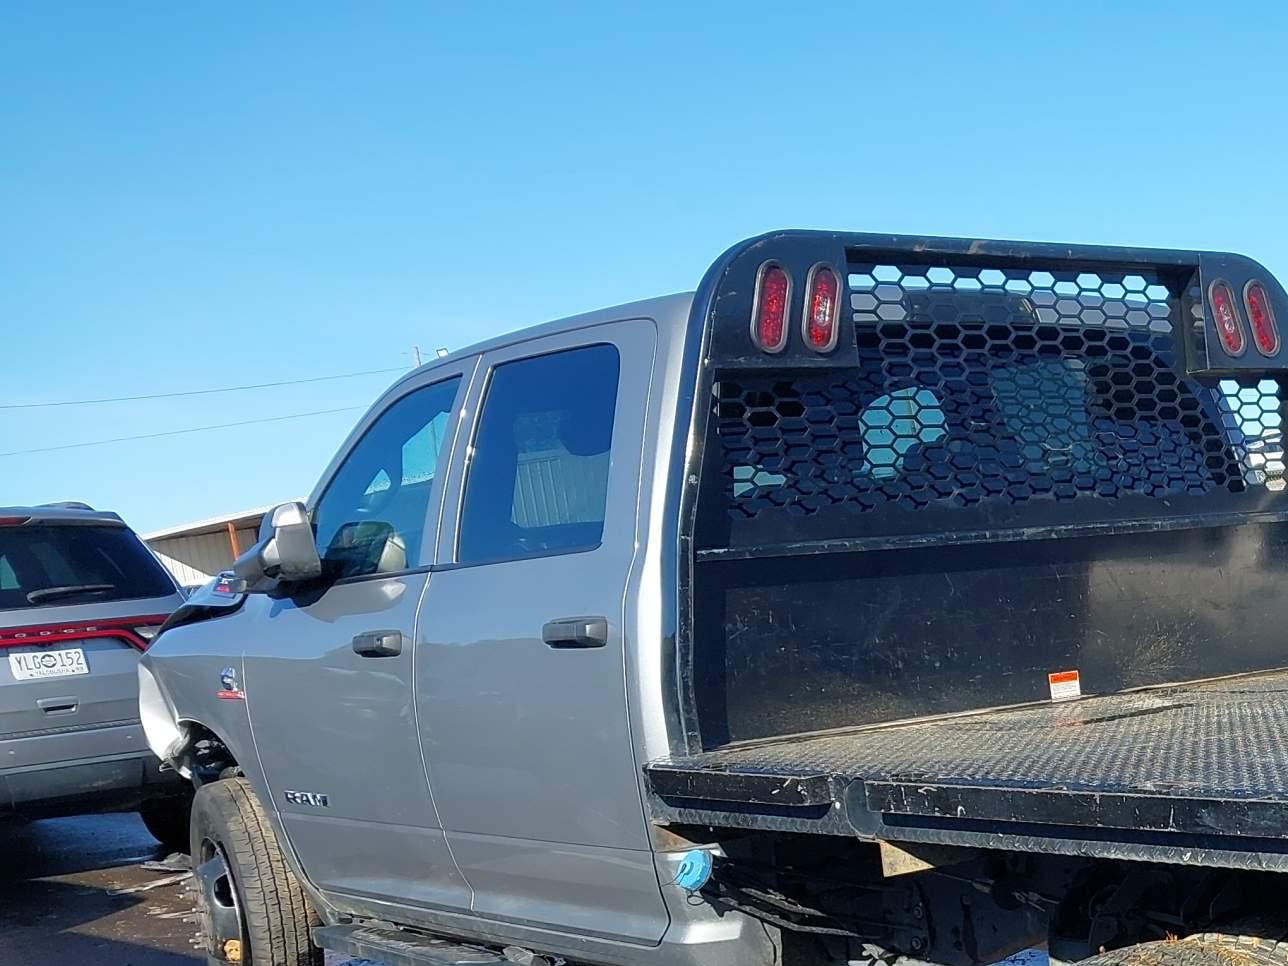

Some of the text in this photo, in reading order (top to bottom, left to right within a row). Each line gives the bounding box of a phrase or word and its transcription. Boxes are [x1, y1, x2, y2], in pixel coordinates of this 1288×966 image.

[0, 626, 97, 639] ODGE
[15, 650, 83, 671] YLG 152
[284, 789, 330, 807] RAM
